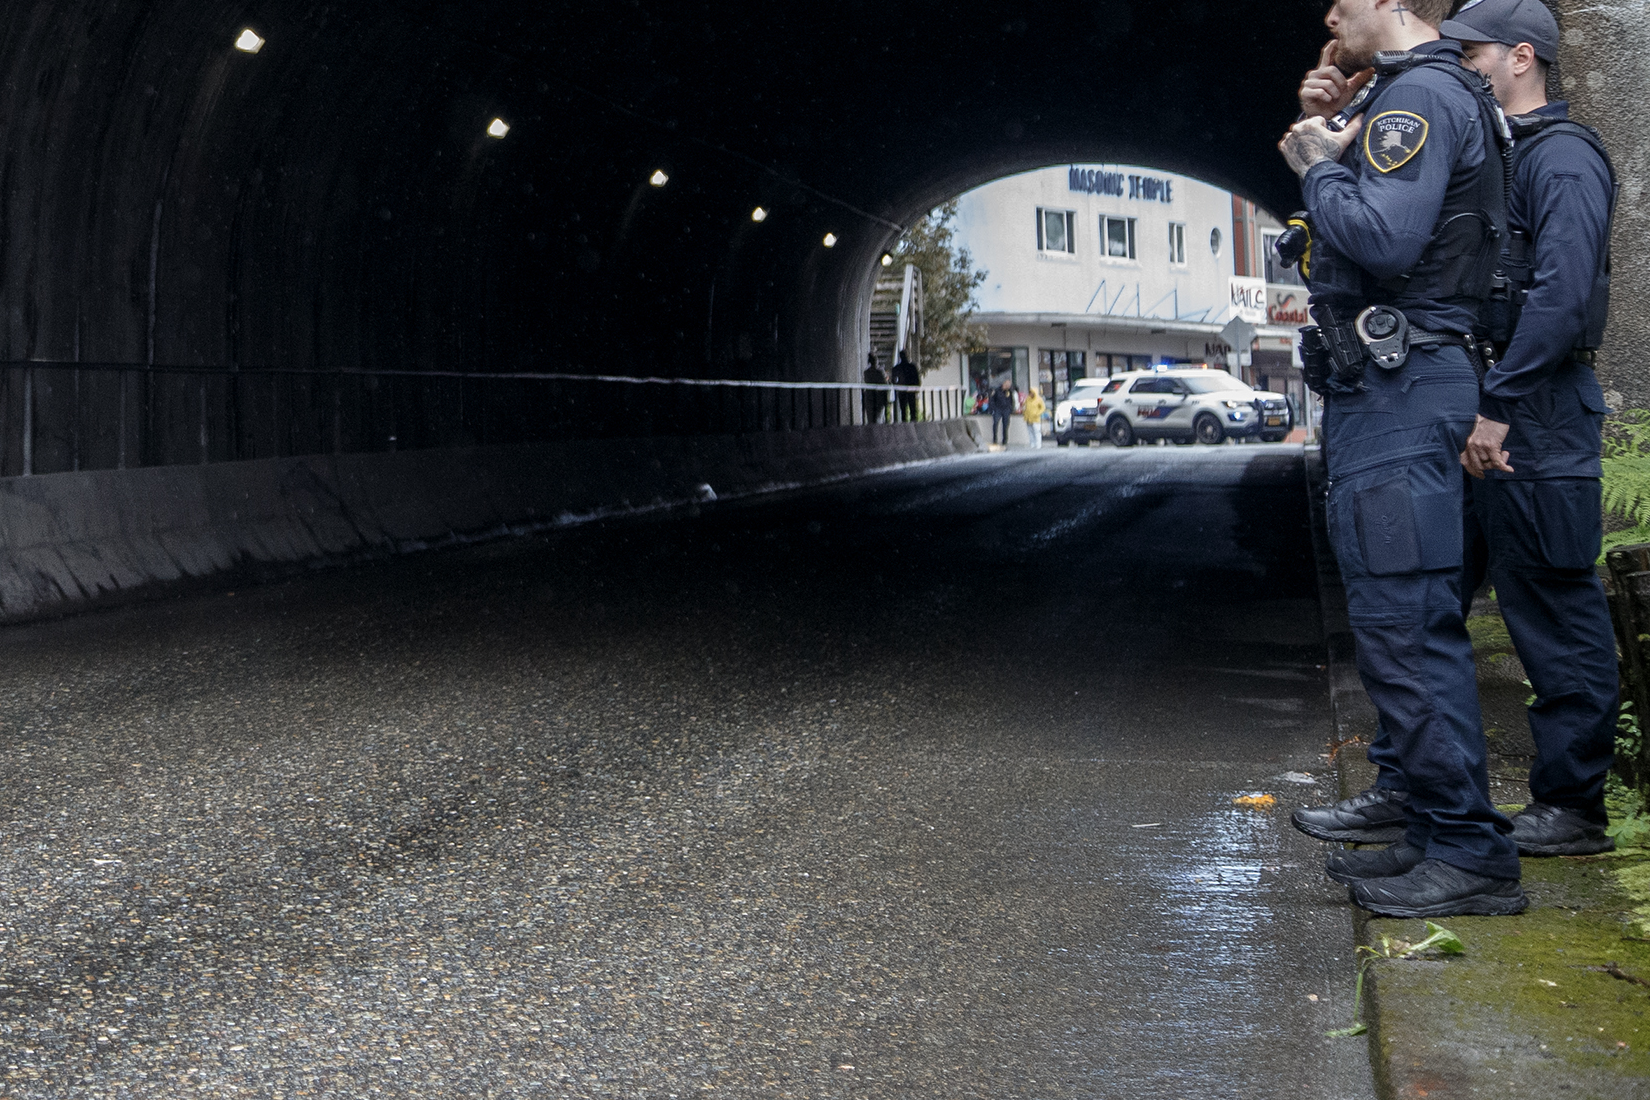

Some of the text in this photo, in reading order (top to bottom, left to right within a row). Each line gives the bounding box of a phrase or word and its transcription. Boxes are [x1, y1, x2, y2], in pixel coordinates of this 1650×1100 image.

[1377, 118, 1420, 127] KETCHIKAN
[1380, 124, 1414, 133] POLICE
[1230, 282, 1265, 309] NAILS
